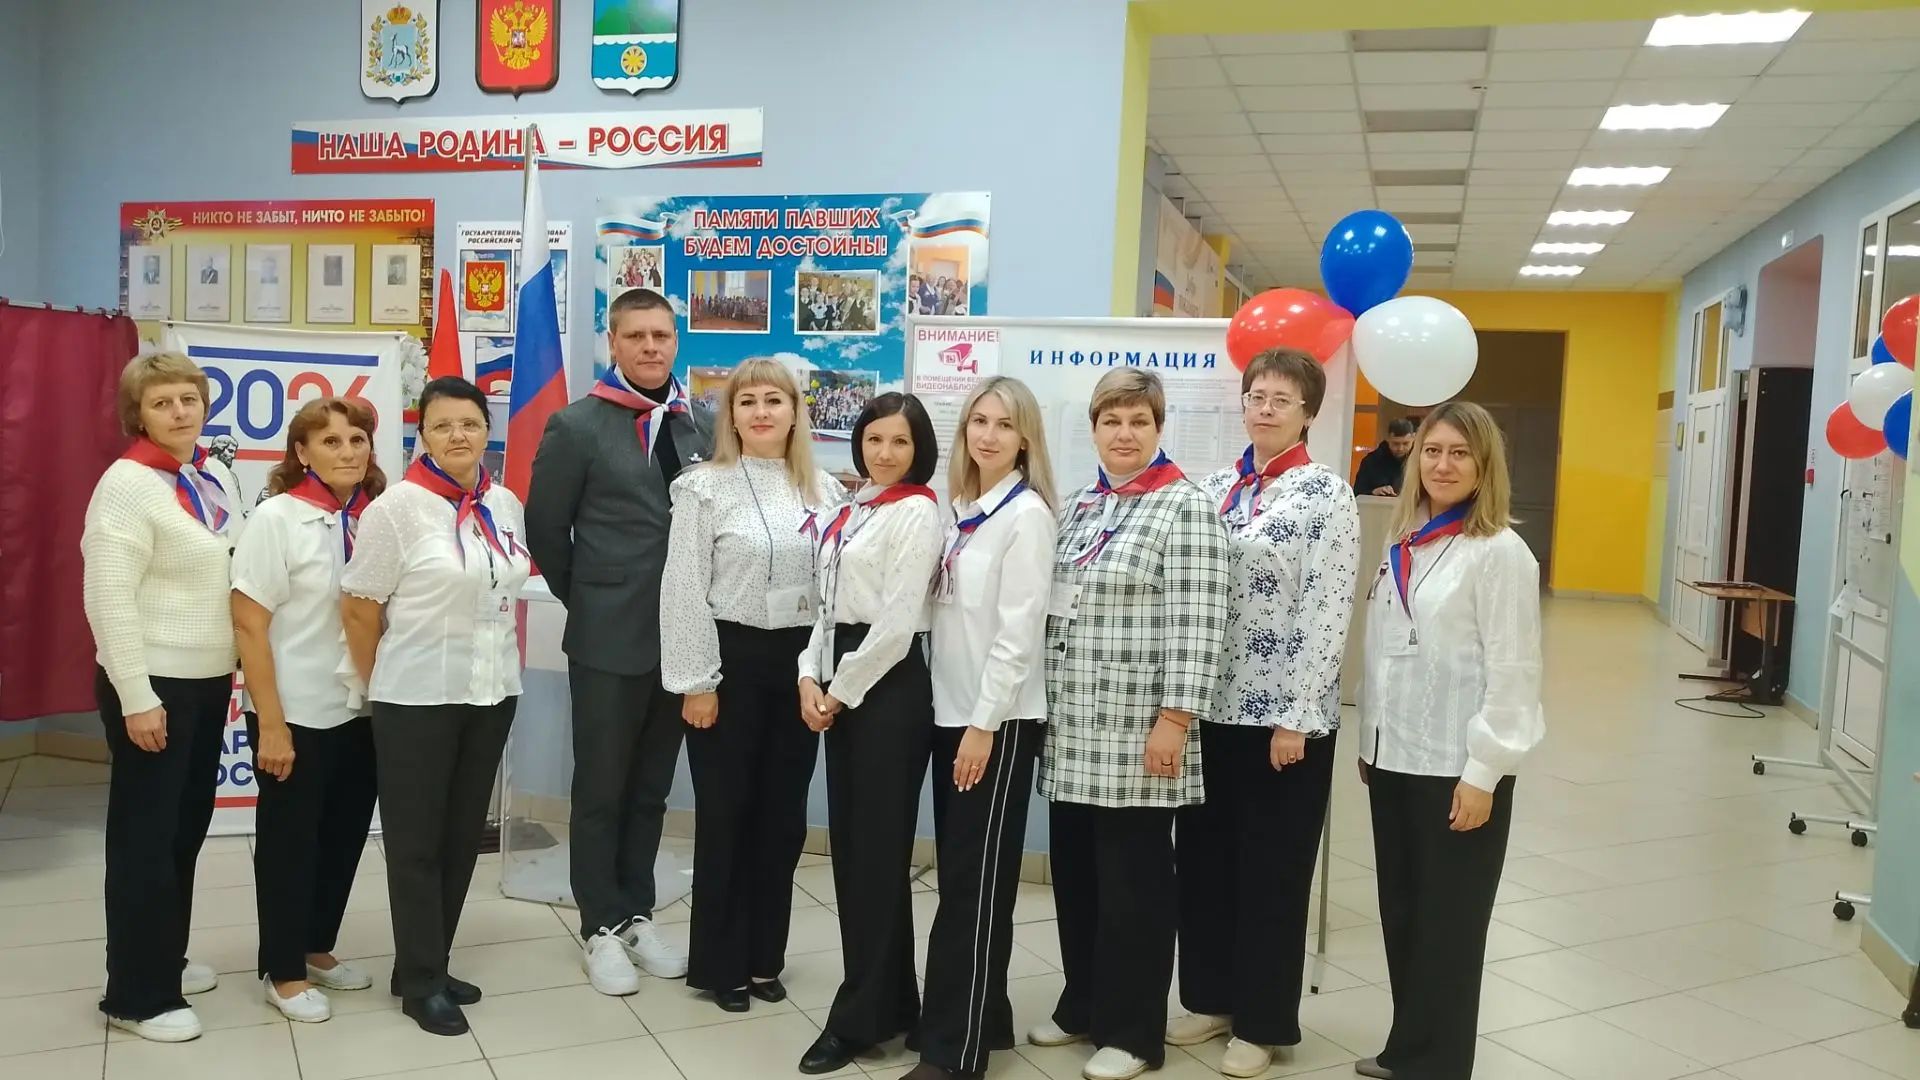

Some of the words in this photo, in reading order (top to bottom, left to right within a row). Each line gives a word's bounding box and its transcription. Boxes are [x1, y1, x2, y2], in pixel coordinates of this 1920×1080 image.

[318, 130, 406, 160] НАША
[418, 126, 546, 163] РОДИНА
[588, 123, 730, 156] РОССИЯ
[192, 211, 233, 224] НИКТО
[236, 211, 252, 223] НЕ
[255, 210, 298, 225] ЗАБЫТ,
[301, 209, 345, 223] НИЧТО
[349, 209, 365, 222] НЕ
[368, 209, 426, 223] ЗАБЫТО!
[693, 208, 779, 229] ПАМЯТИ
[785, 208, 881, 229] ПАВШИХ
[684, 235, 752, 259] БУДЕМ
[756, 233, 888, 260] ДОСТОЙНЫ!
[918, 329, 1000, 342] ВНИМАНИЕ!
[1030, 350, 1216, 370] ИНФОРМАЦИЯ
[916, 382, 976, 391] ВИДЕОНАБЛЮД
